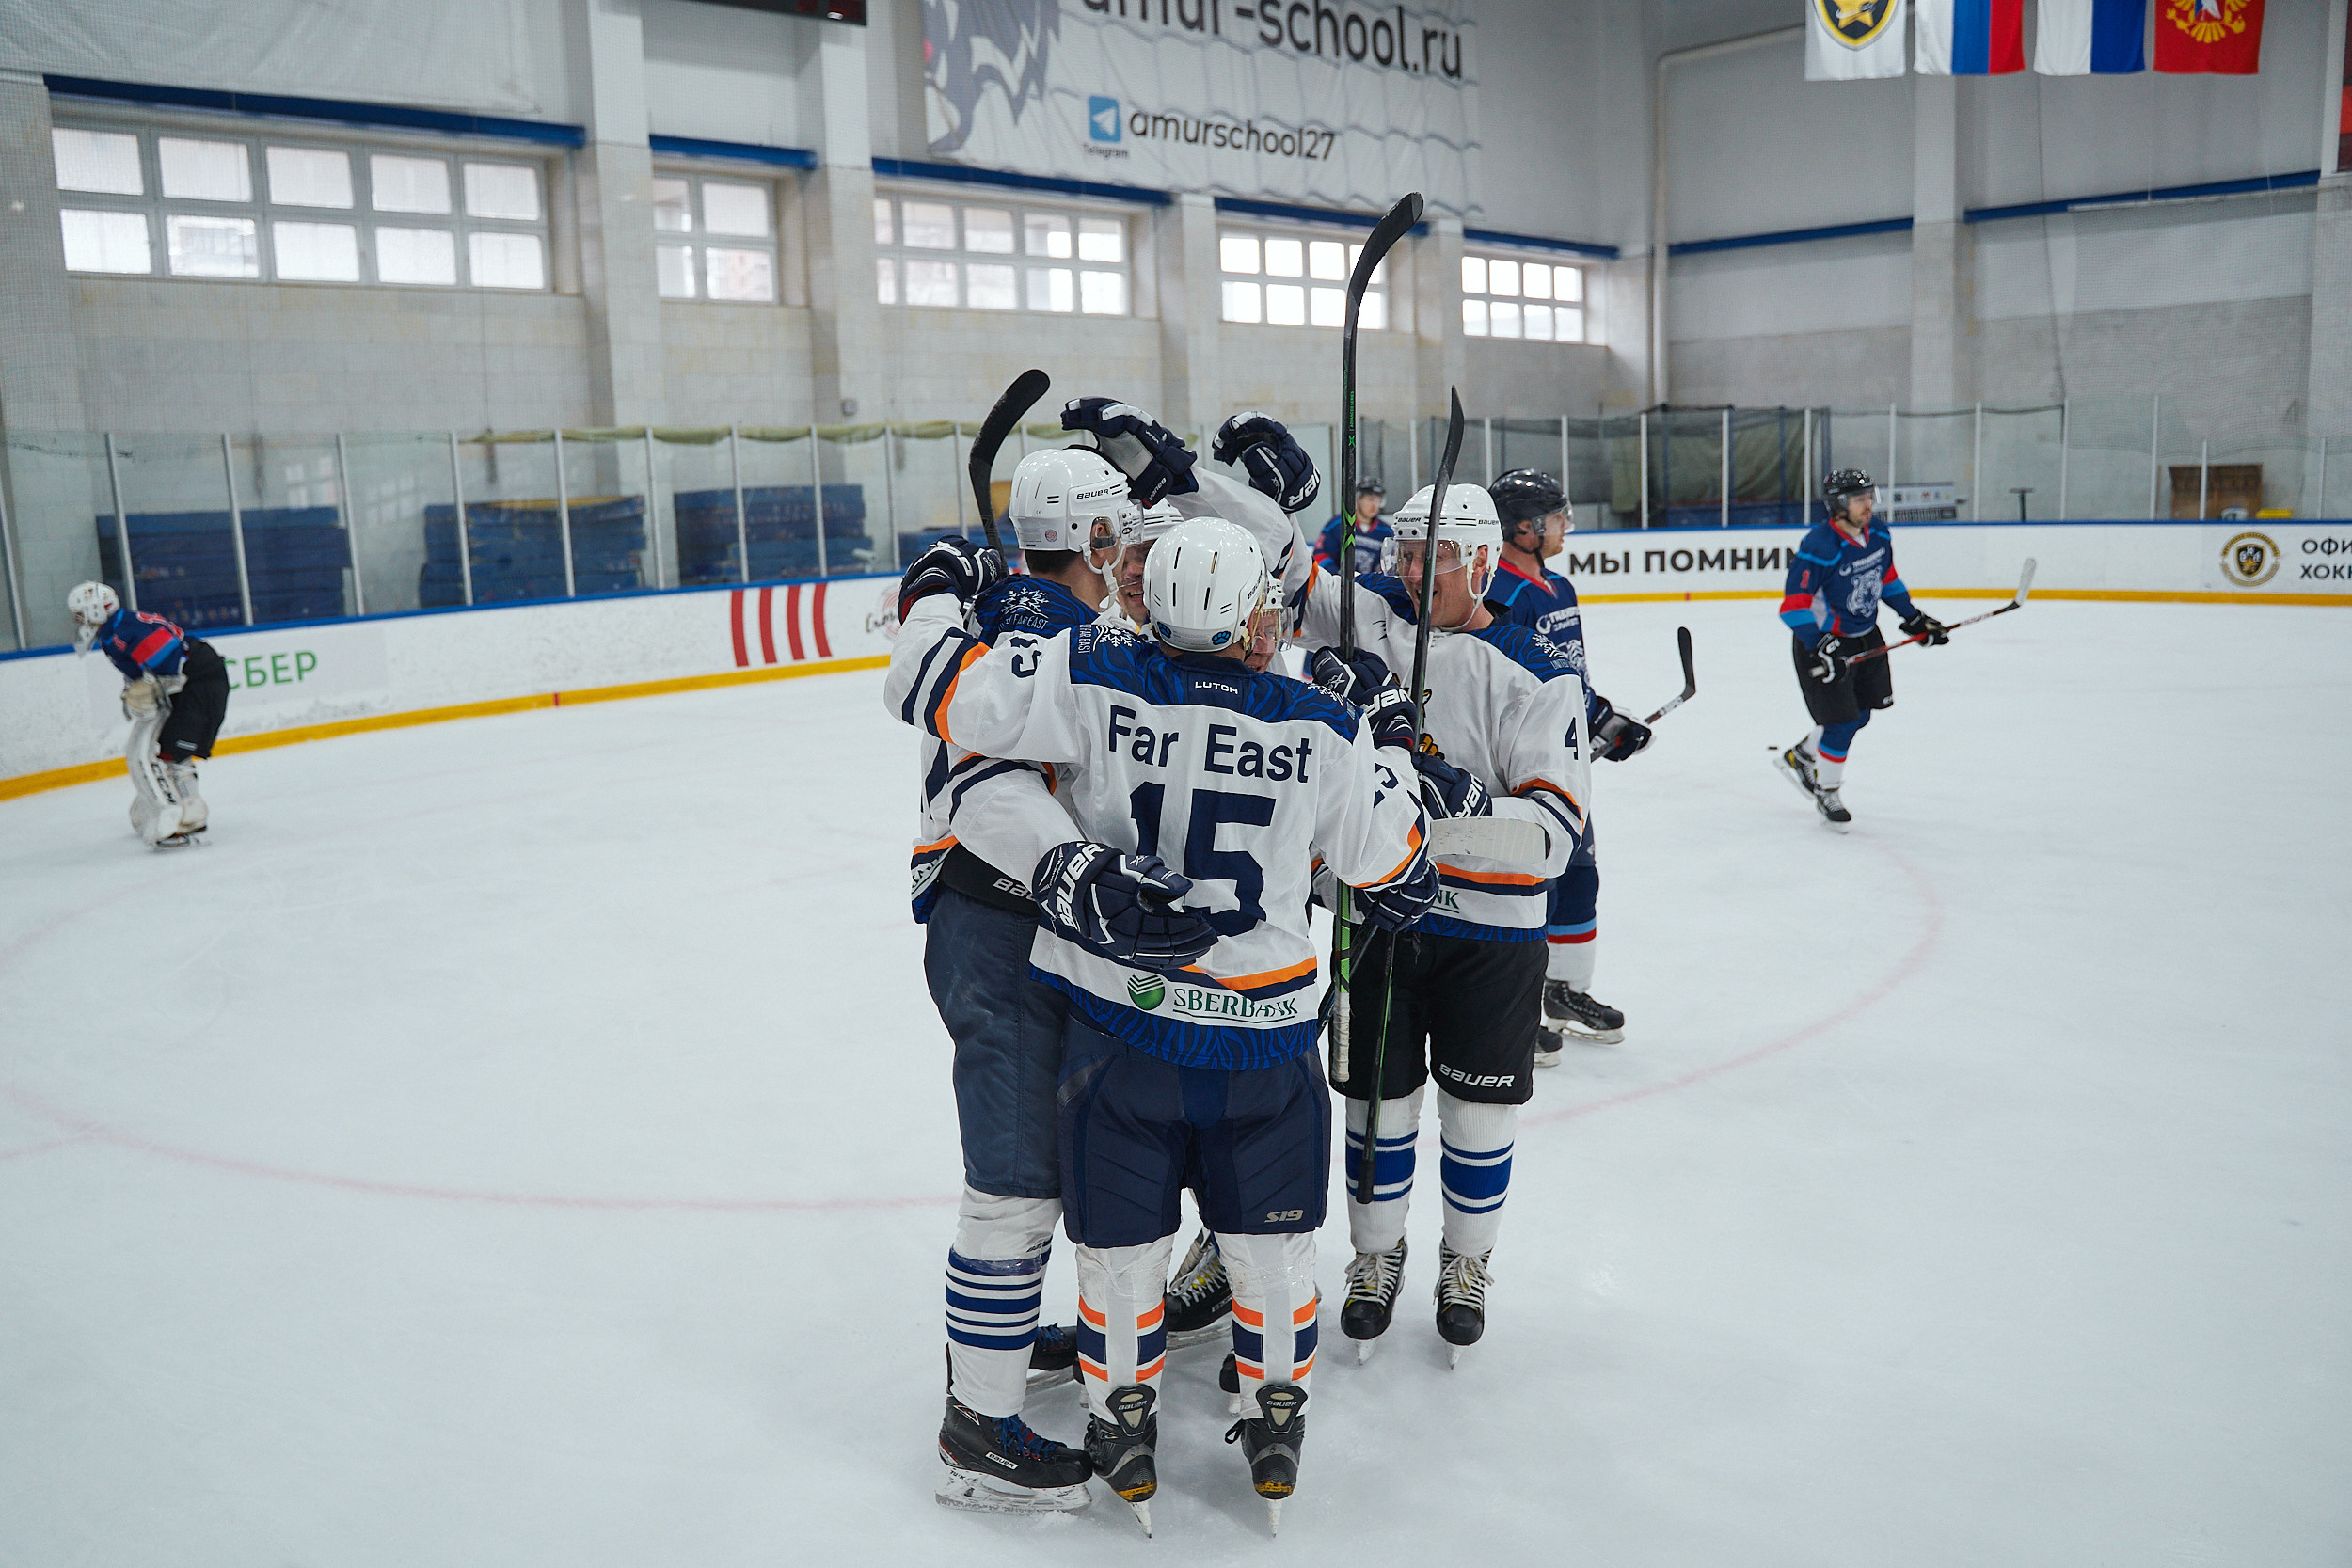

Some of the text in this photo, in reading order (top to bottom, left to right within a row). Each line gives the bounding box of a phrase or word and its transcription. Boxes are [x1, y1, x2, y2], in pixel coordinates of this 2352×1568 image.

[1084, 0, 1462, 79] ur-school.ru
[1130, 112, 1335, 161] amurschool27
[1076, 488, 1109, 499] BAUER
[1569, 552, 1629, 575] МЫ
[1027, 613, 1049, 630] EAST
[1078, 638, 1091, 654] EAST
[1195, 681, 1239, 695] LUTCH
[1108, 704, 1313, 784] Far East
[1129, 781, 1277, 937] 15
[1056, 843, 1105, 932] BAUER
[1438, 1063, 1515, 1088] BAUER
[1263, 1209, 1304, 1223] S19
[1118, 1400, 1148, 1411] BAUER
[987, 1452, 1016, 1469] BAUER
